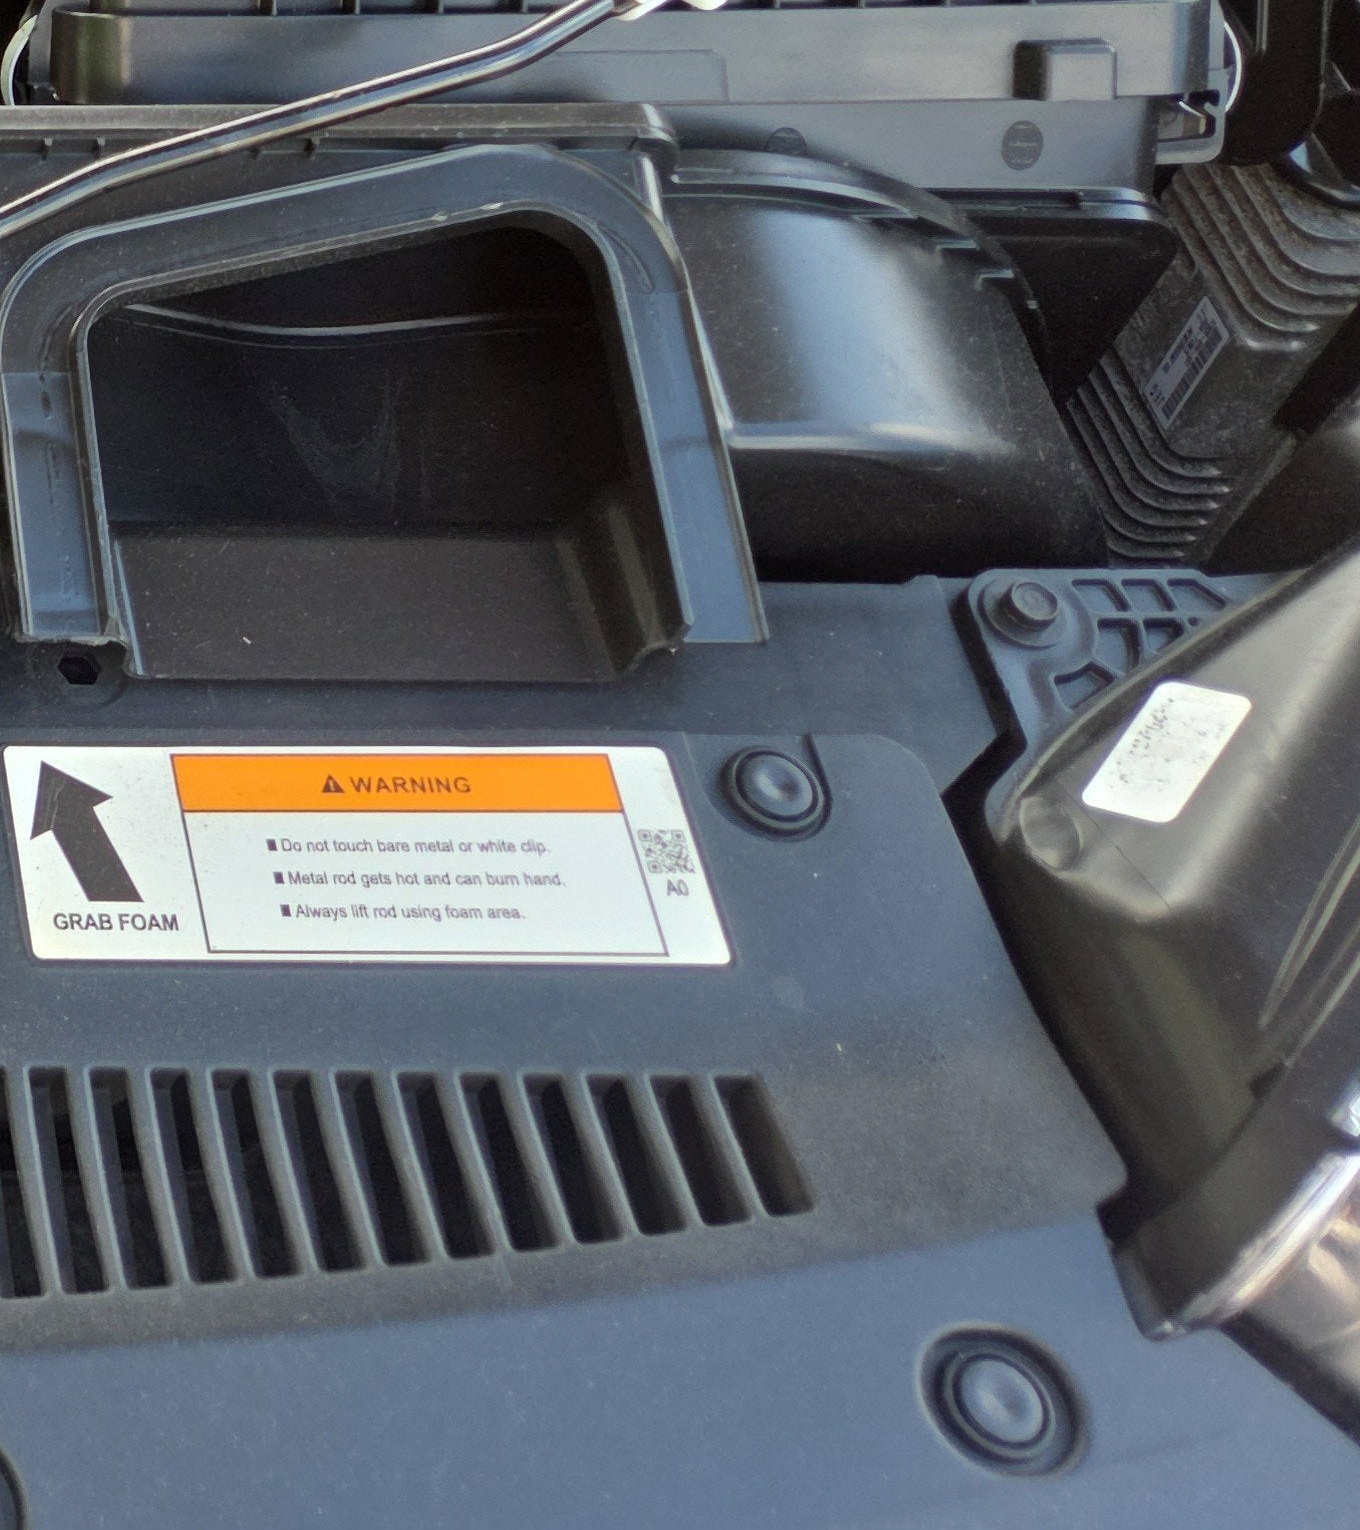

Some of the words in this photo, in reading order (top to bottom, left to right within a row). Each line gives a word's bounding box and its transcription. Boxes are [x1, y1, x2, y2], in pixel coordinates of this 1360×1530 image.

[349, 775, 472, 794] WARNING
[280, 838, 302, 853] Do
[306, 839, 330, 853] not
[333, 839, 373, 853] touch
[377, 839, 410, 853] bare
[414, 839, 455, 853] metal
[458, 841, 473, 853] or
[477, 840, 517, 854] white
[520, 840, 551, 856] clip.
[288, 871, 328, 885] Metal
[333, 871, 357, 885] rod
[361, 872, 392, 888] gets
[396, 872, 420, 885] hot
[423, 872, 451, 886] and
[455, 874, 481, 886] can
[485, 872, 520, 886] burn
[523, 872, 566, 887] hand.
[295, 904, 347, 921] Always
[351, 904, 368, 918] lift
[373, 904, 397, 918] rod
[401, 904, 441, 922] using
[444, 904, 482, 919] foam
[486, 907, 527, 920] area.
[53, 913, 114, 932] GRAB
[119, 913, 180, 932] FOAM
